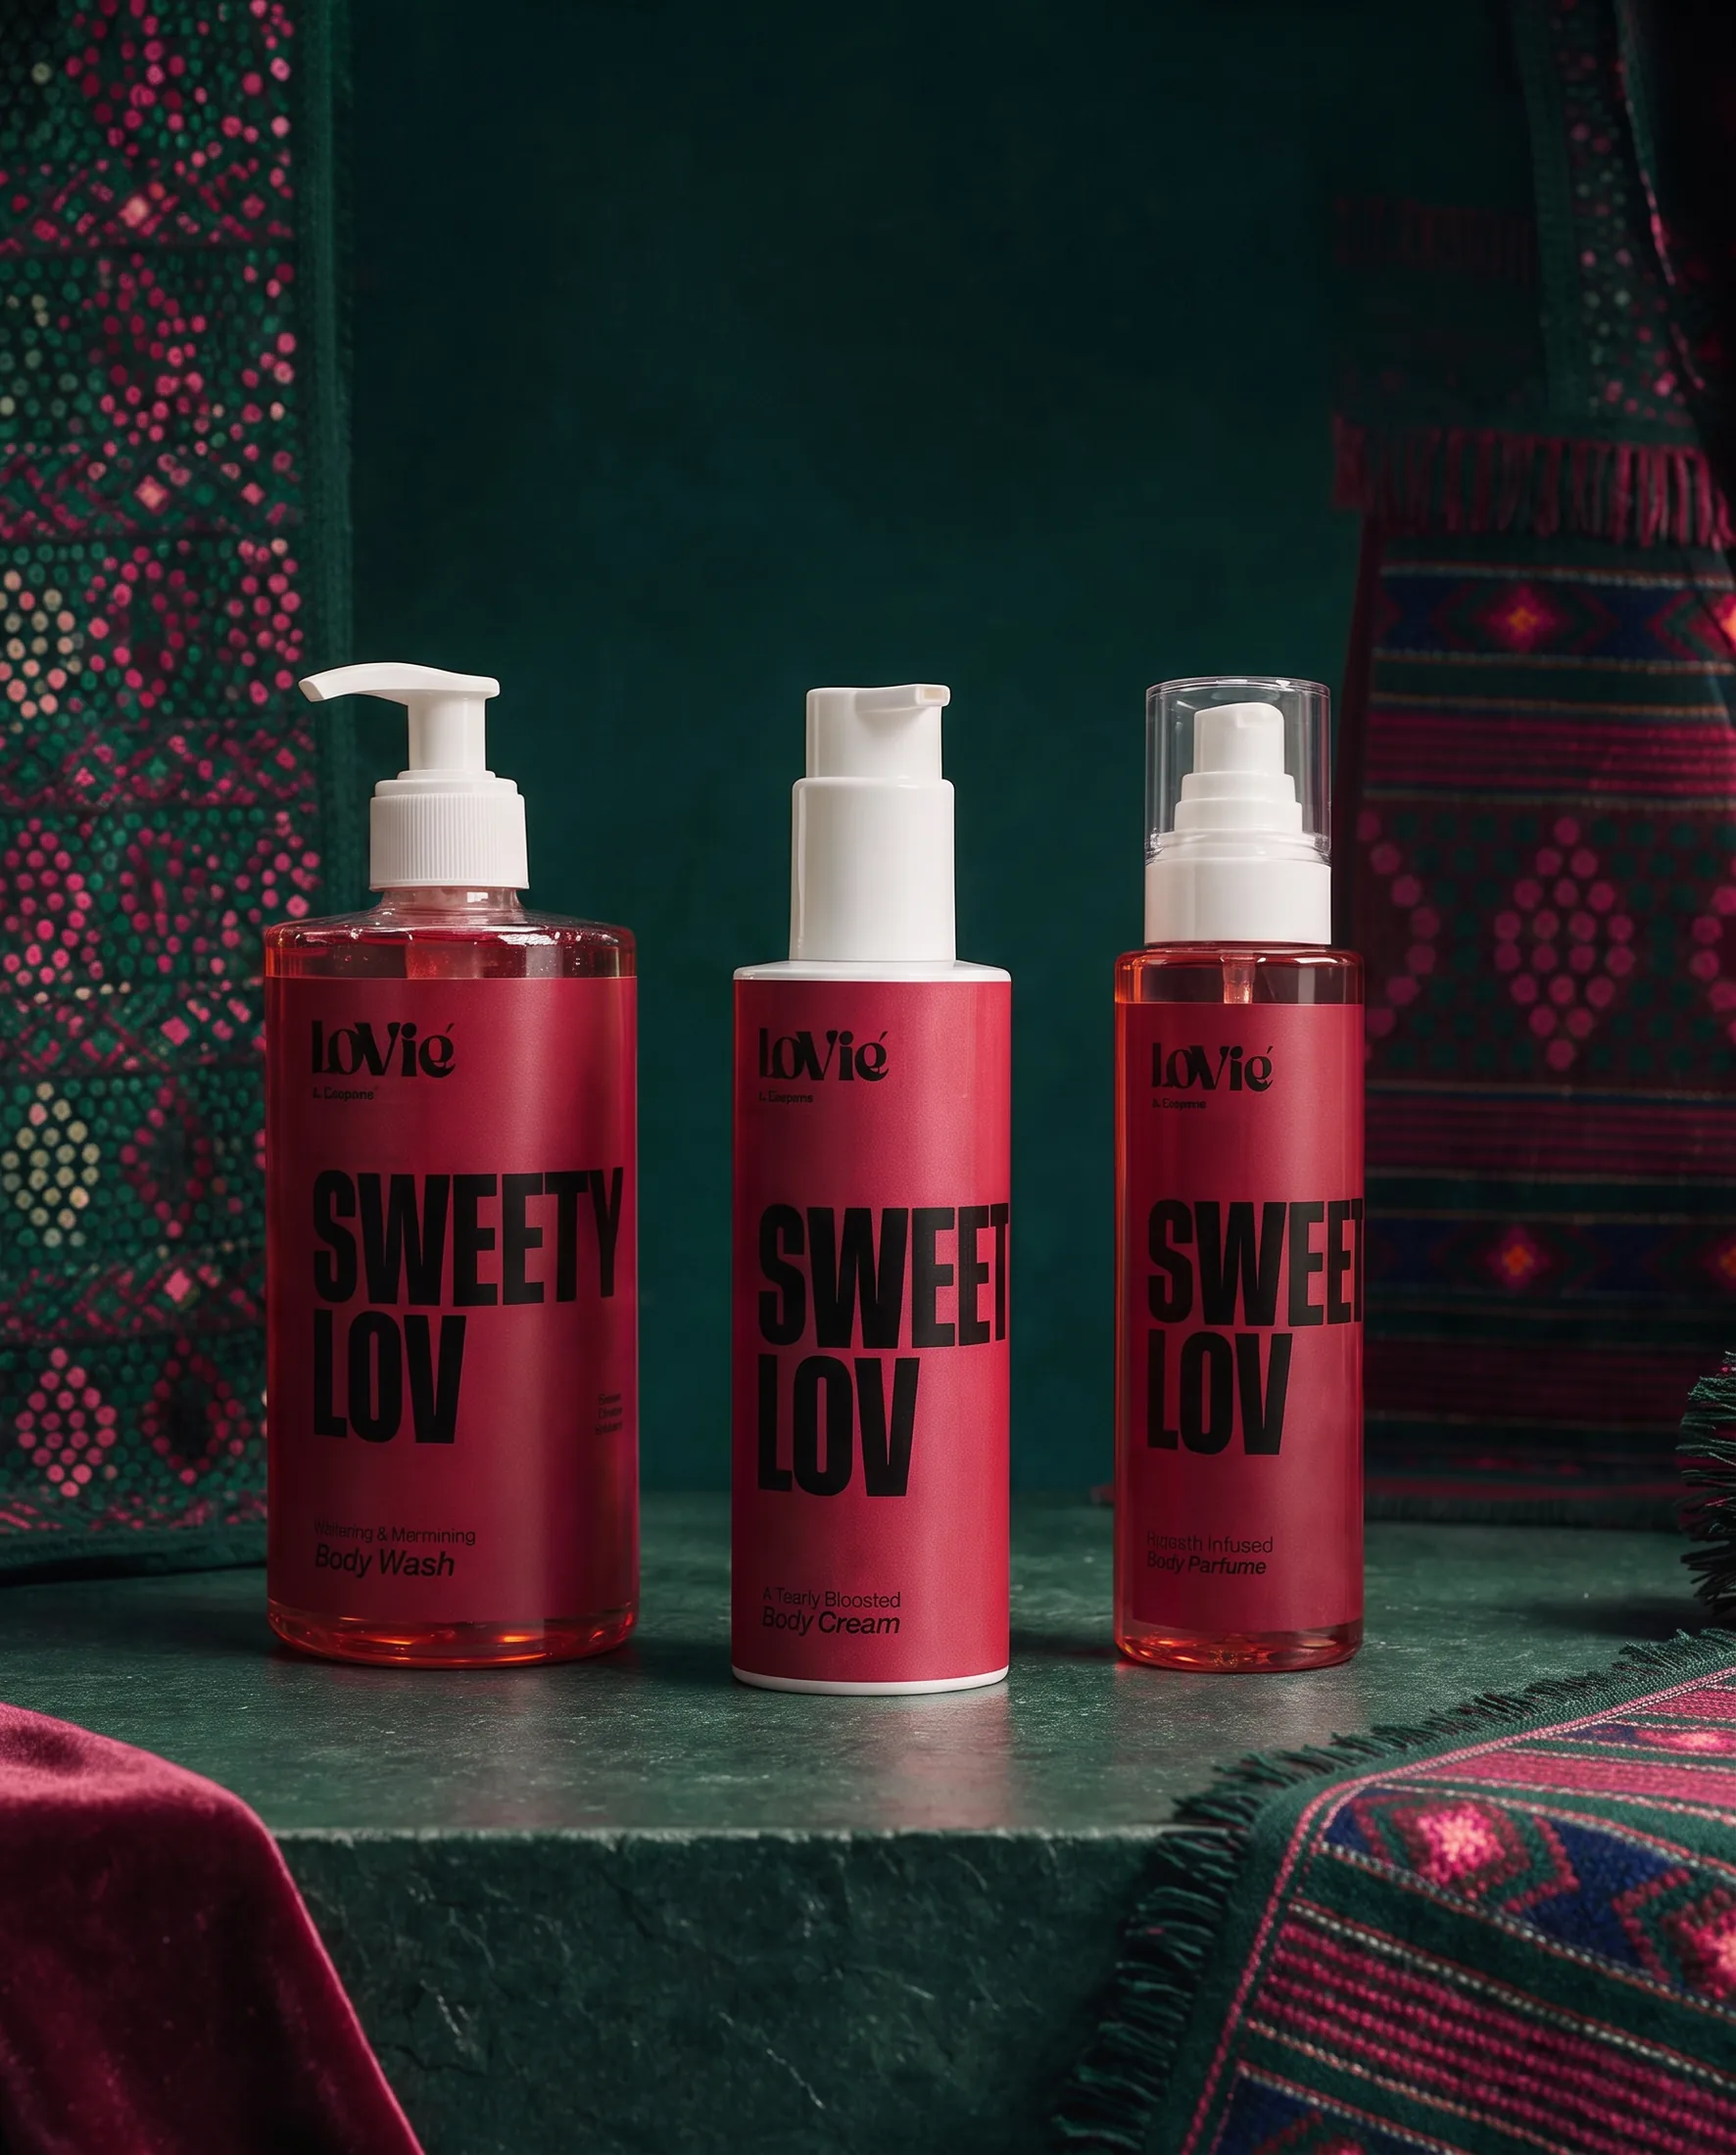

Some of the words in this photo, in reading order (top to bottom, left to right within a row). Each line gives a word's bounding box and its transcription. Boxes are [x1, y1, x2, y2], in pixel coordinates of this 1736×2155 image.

[313, 1166, 624, 1308] SWEETY
[757, 1202, 1009, 1350] SWEET
[1147, 1197, 1364, 1327] SWEET
[313, 1308, 467, 1445] LOV
[1146, 1328, 1293, 1457] LOV
[757, 1353, 921, 1498] LOV
[314, 1543, 373, 1579] Body
[379, 1548, 456, 1577] Wash
[377, 1526, 387, 1542] &
[1147, 1550, 1186, 1575] Body
[1187, 1555, 1267, 1575] Parfume
[1208, 1534, 1274, 1554] Infused
[761, 1605, 814, 1637] Body
[818, 1611, 900, 1635] Cream
[762, 1586, 772, 1601] A
[775, 1587, 821, 1610] Tearly
[825, 1591, 901, 1608] Bloosted
